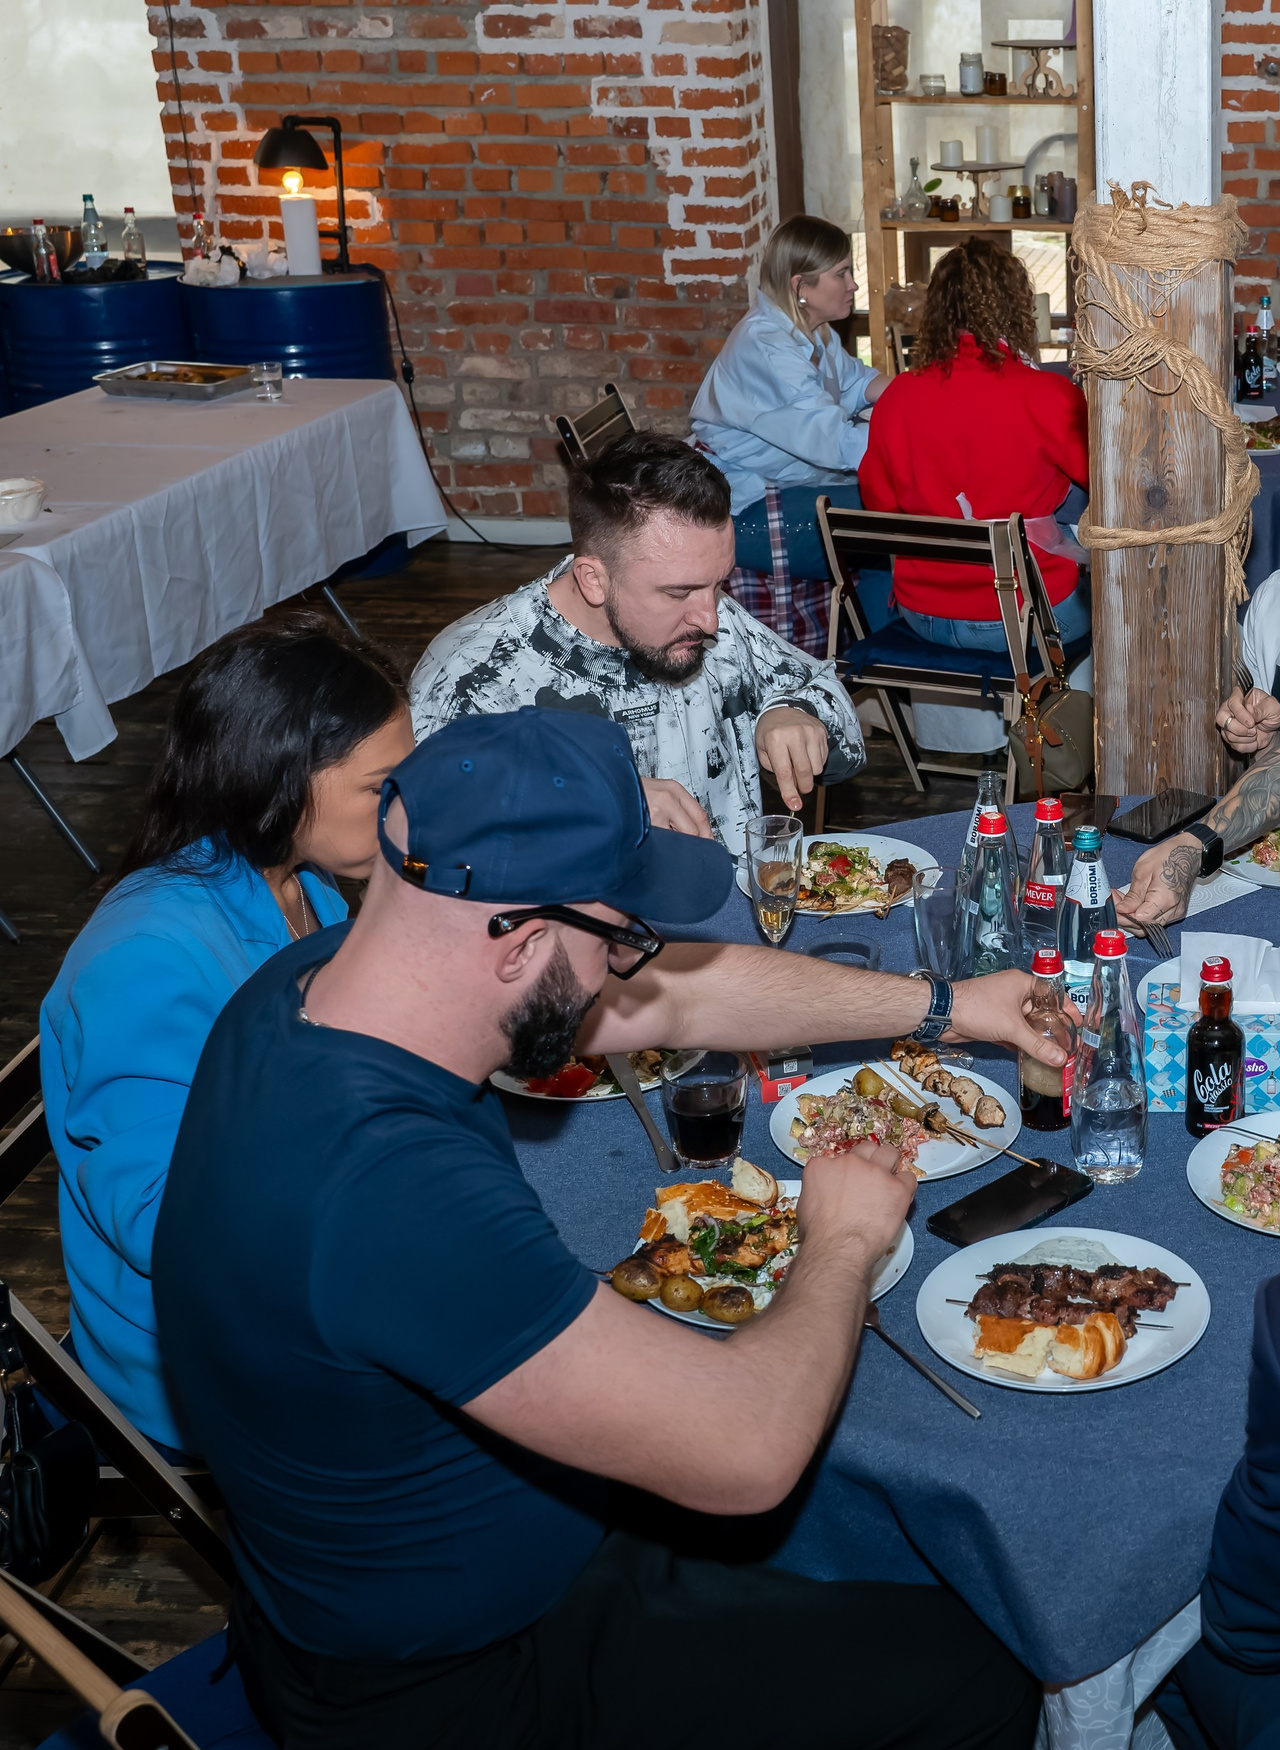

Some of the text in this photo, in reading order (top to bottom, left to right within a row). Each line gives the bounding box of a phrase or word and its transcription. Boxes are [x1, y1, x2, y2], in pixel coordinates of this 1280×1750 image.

[1026, 888, 1053, 901] MEVER
[1088, 865, 1098, 905] BORJOMI
[1193, 1062, 1231, 1104] Cola
